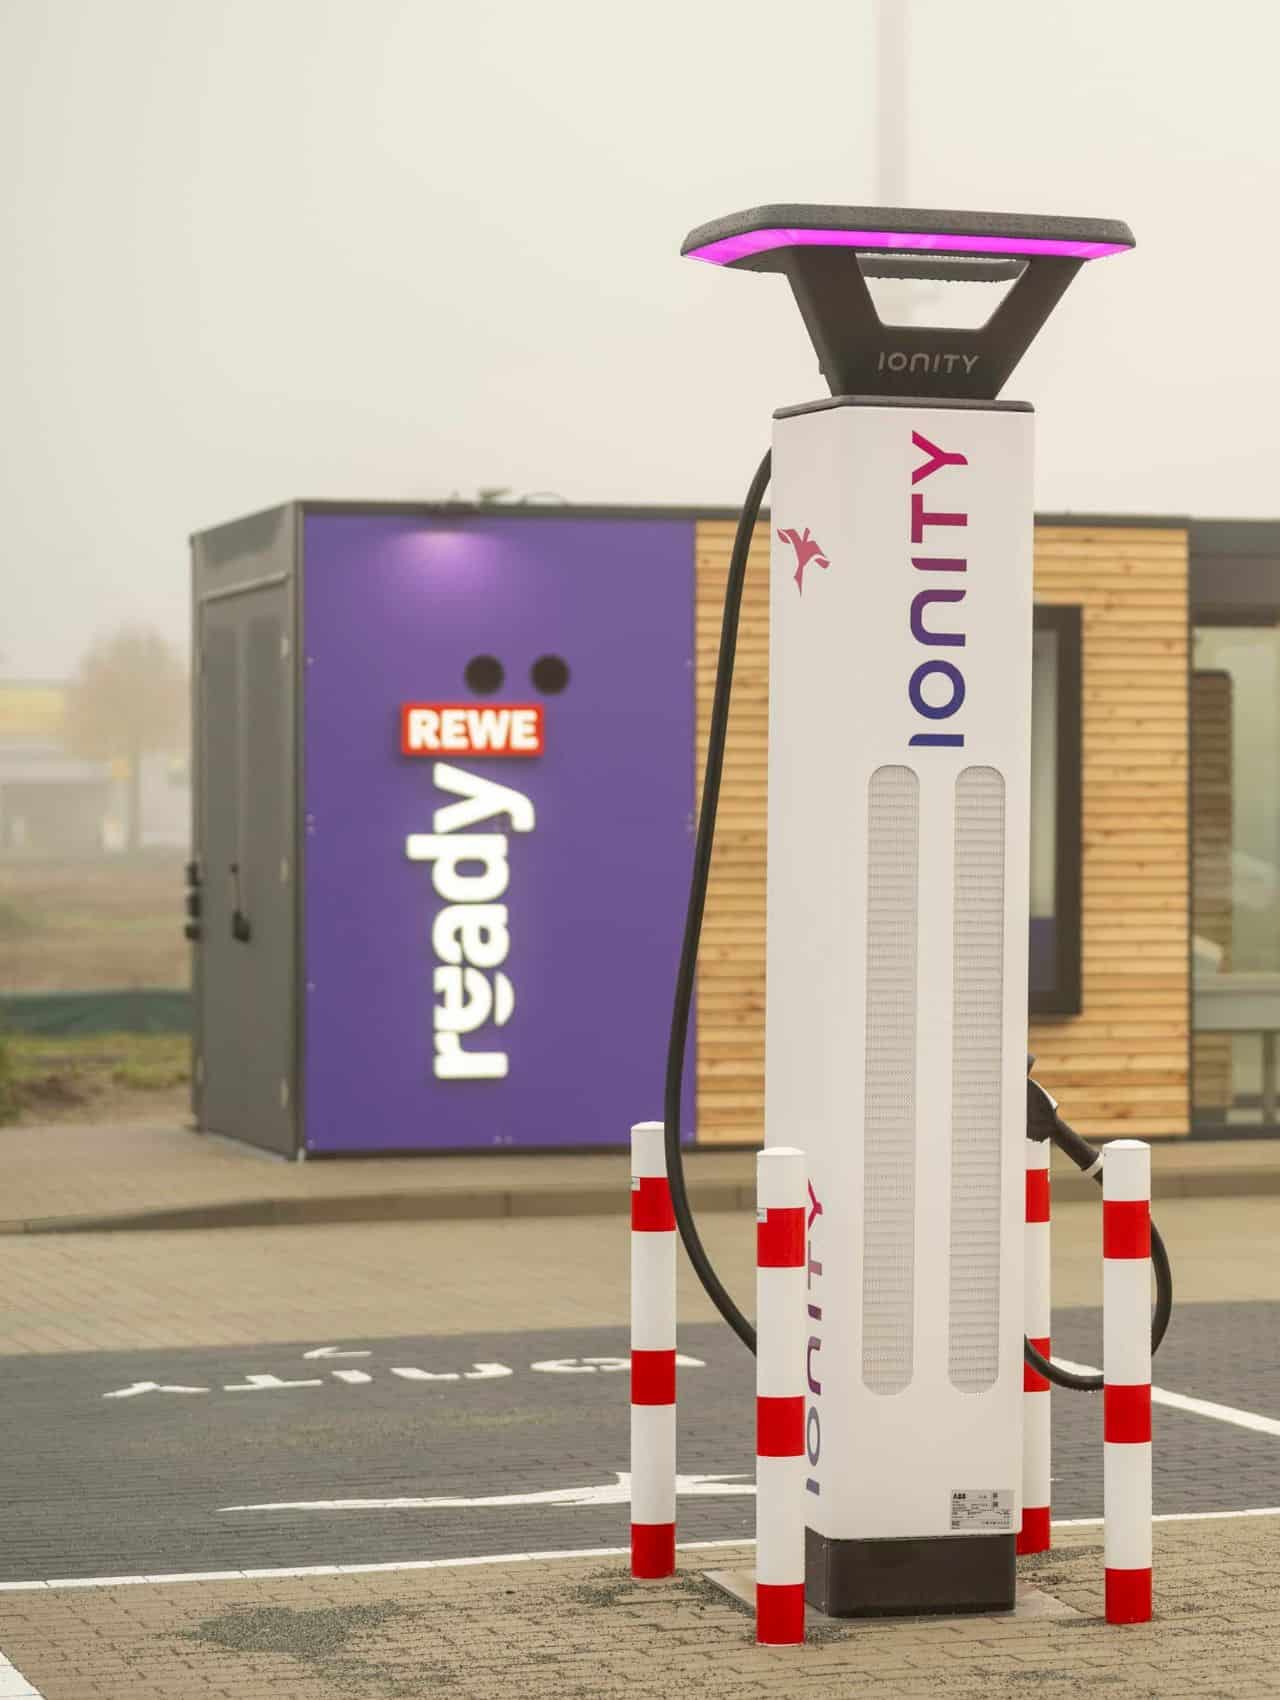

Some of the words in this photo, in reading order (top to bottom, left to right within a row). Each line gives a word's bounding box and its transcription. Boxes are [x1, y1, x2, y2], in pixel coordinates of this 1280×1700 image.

[878, 351, 979, 374] IONITY
[908, 430, 968, 747] IONITY
[408, 708, 540, 750] REWE
[406, 762, 536, 1079] ready
